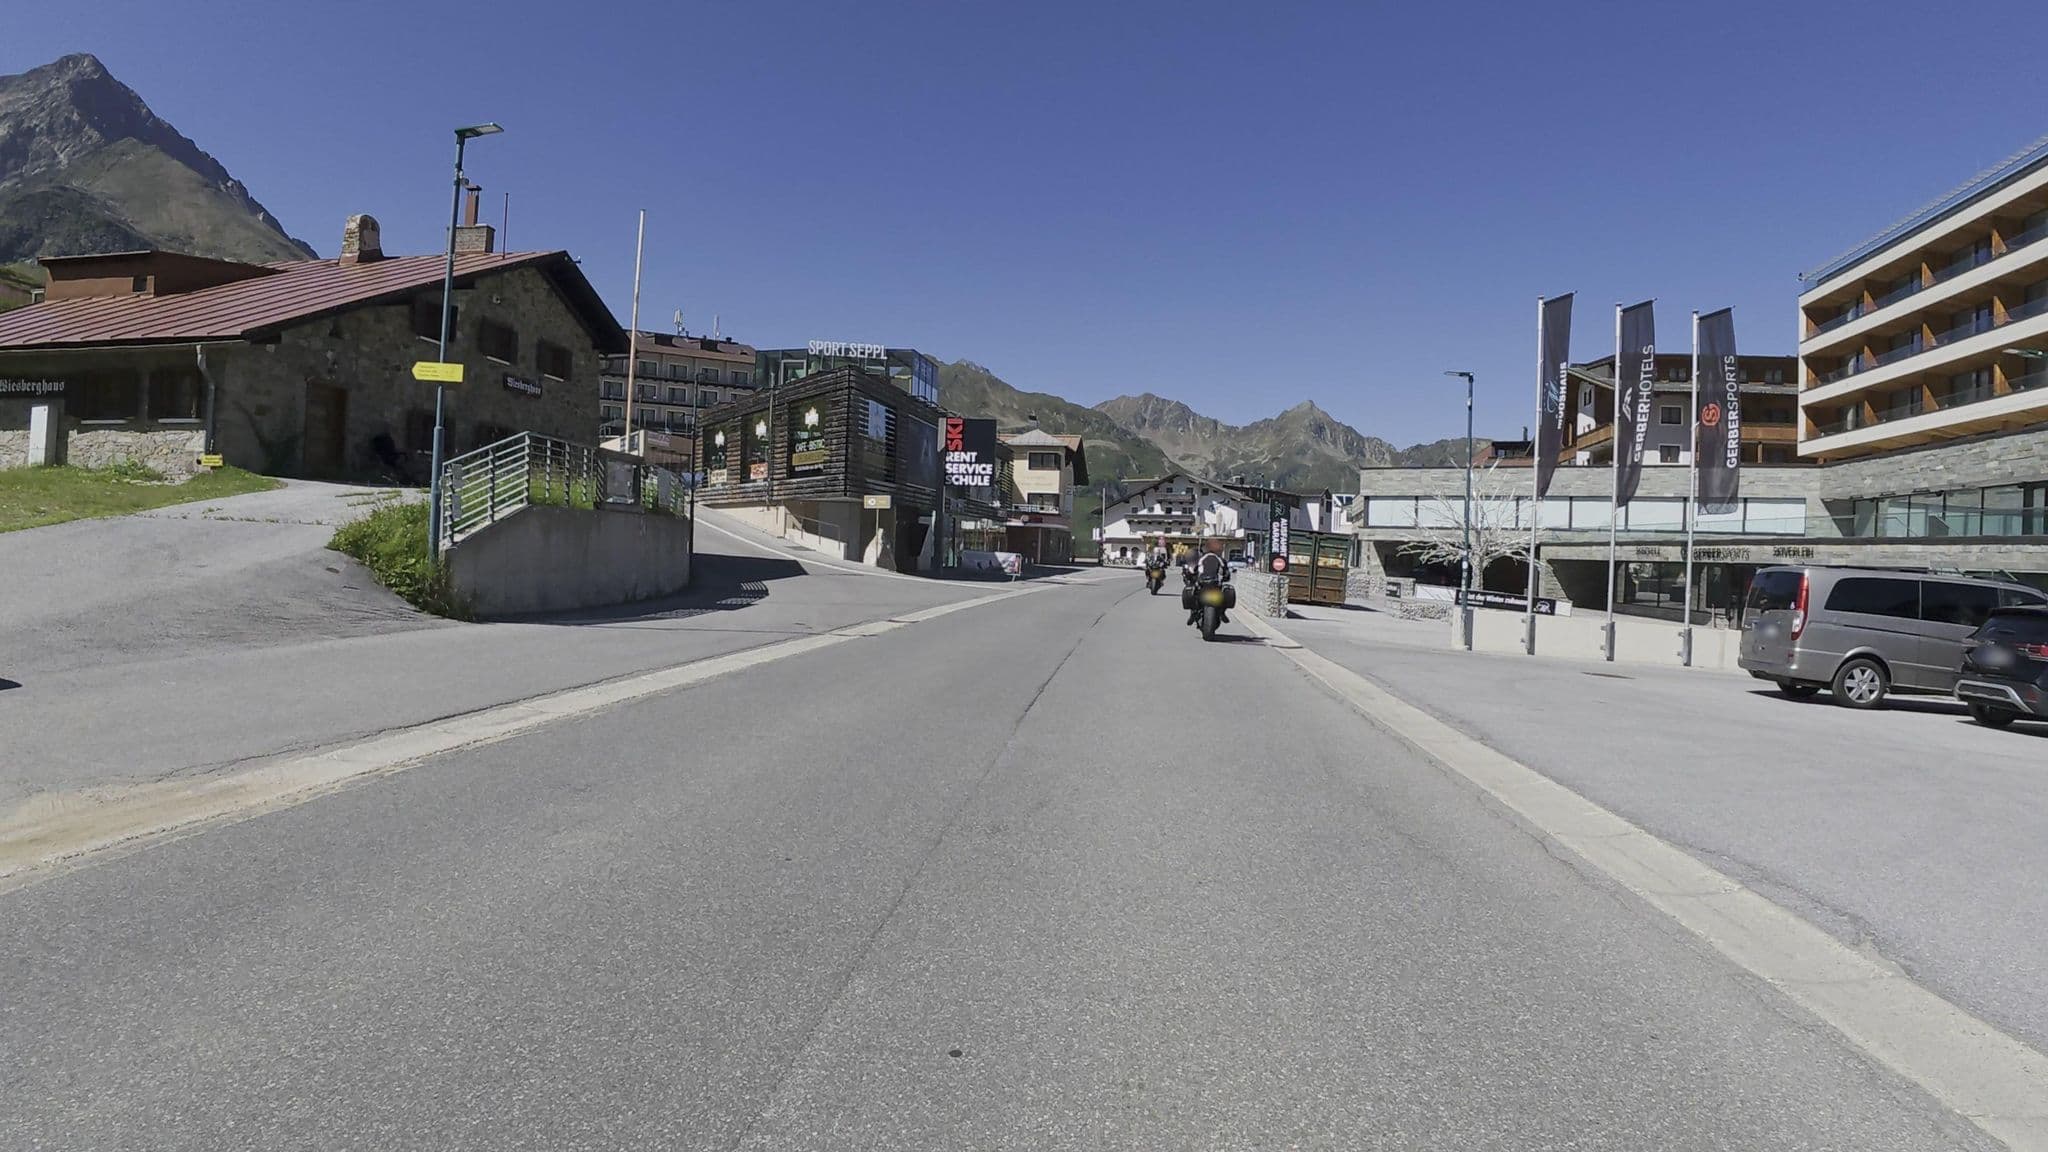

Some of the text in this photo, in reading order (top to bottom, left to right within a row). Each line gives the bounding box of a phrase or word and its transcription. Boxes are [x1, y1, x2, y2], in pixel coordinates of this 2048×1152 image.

[808, 340, 888, 360] SPORT SEPPL
[1633, 344, 1654, 462] GERBERHOTELS
[1725, 355, 1739, 469] GERBERSPORTS
[947, 418, 963, 451] SKI
[945, 451, 978, 462] RENT
[945, 463, 993, 475] SERVICE
[945, 474, 991, 486] SCHULE
[1272, 521, 1280, 553] GARAGE
[1280, 517, 1288, 558] AUSFAHRT
